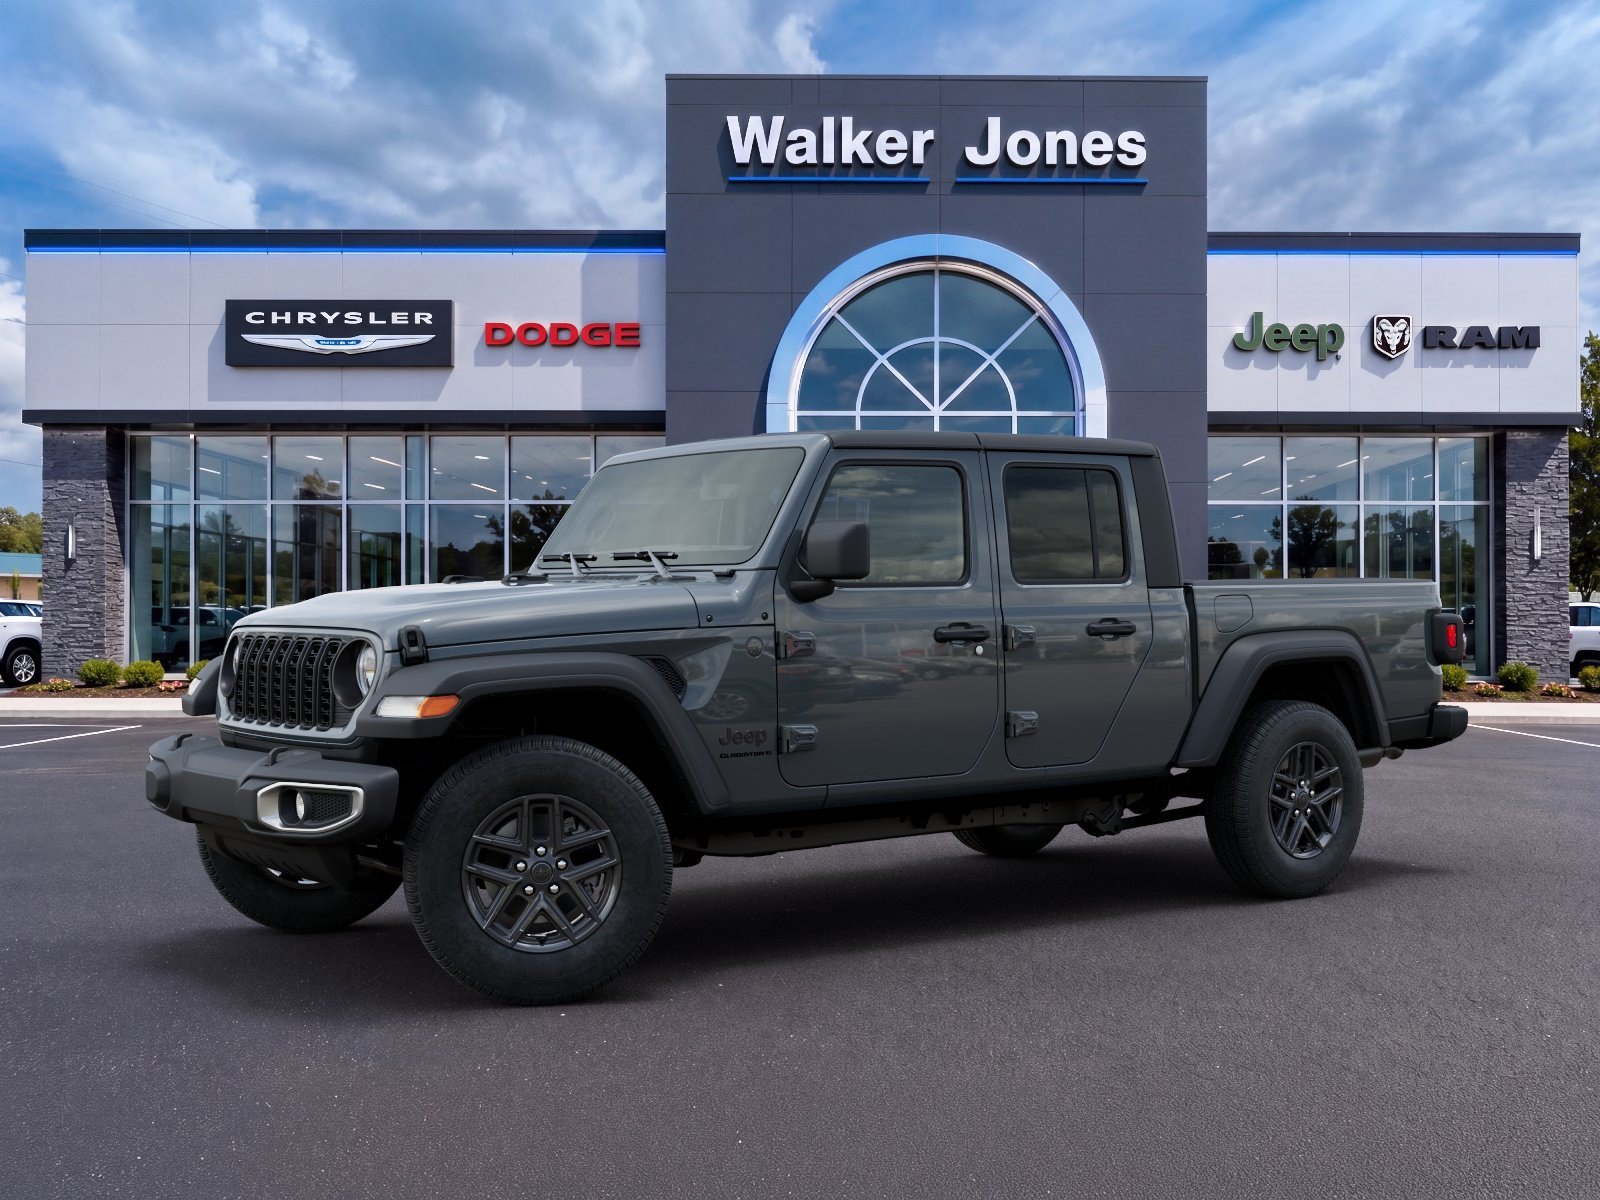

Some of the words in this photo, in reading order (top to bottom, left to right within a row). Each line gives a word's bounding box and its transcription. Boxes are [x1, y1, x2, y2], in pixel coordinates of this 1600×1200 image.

[726, 115, 934, 164] Walker
[964, 116, 1147, 167] Jones
[245, 311, 433, 325] CHRYSLER
[485, 322, 641, 347] DODGE
[1233, 311, 1345, 360] Jeep
[1423, 325, 1541, 349] RAM
[718, 727, 767, 747] Jeep
